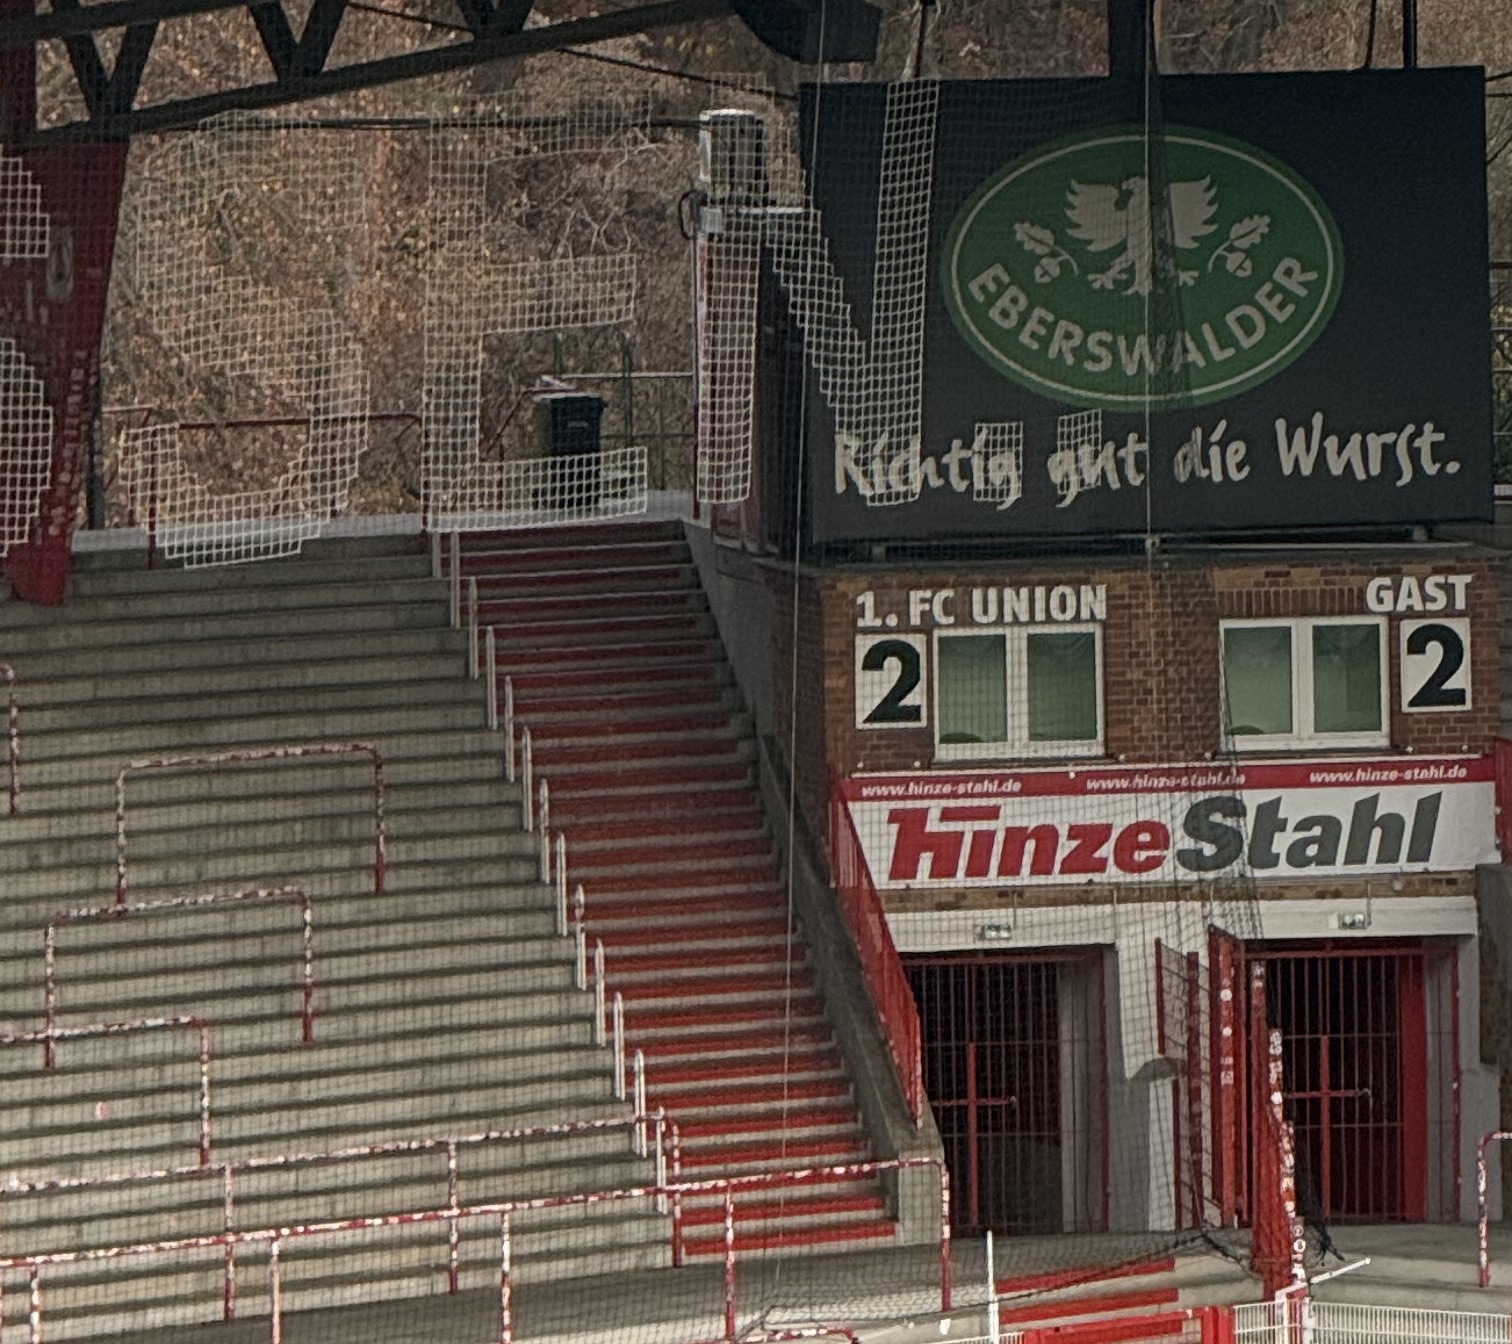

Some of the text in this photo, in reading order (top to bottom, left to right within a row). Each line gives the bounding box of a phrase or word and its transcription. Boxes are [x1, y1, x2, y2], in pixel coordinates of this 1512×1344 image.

[967, 256, 1318, 377] EBERSWALDER
[834, 412, 1461, 510] Richtig gut die Wurst.
[856, 584, 1107, 628] 1. FC UNION
[1366, 574, 1472, 612] GAST
[862, 639, 921, 723] 2
[1407, 624, 1466, 708] 2
[862, 778, 1022, 797] www.hinze-stahl.de
[1310, 765, 1467, 783] www.hinze-stahl.de
